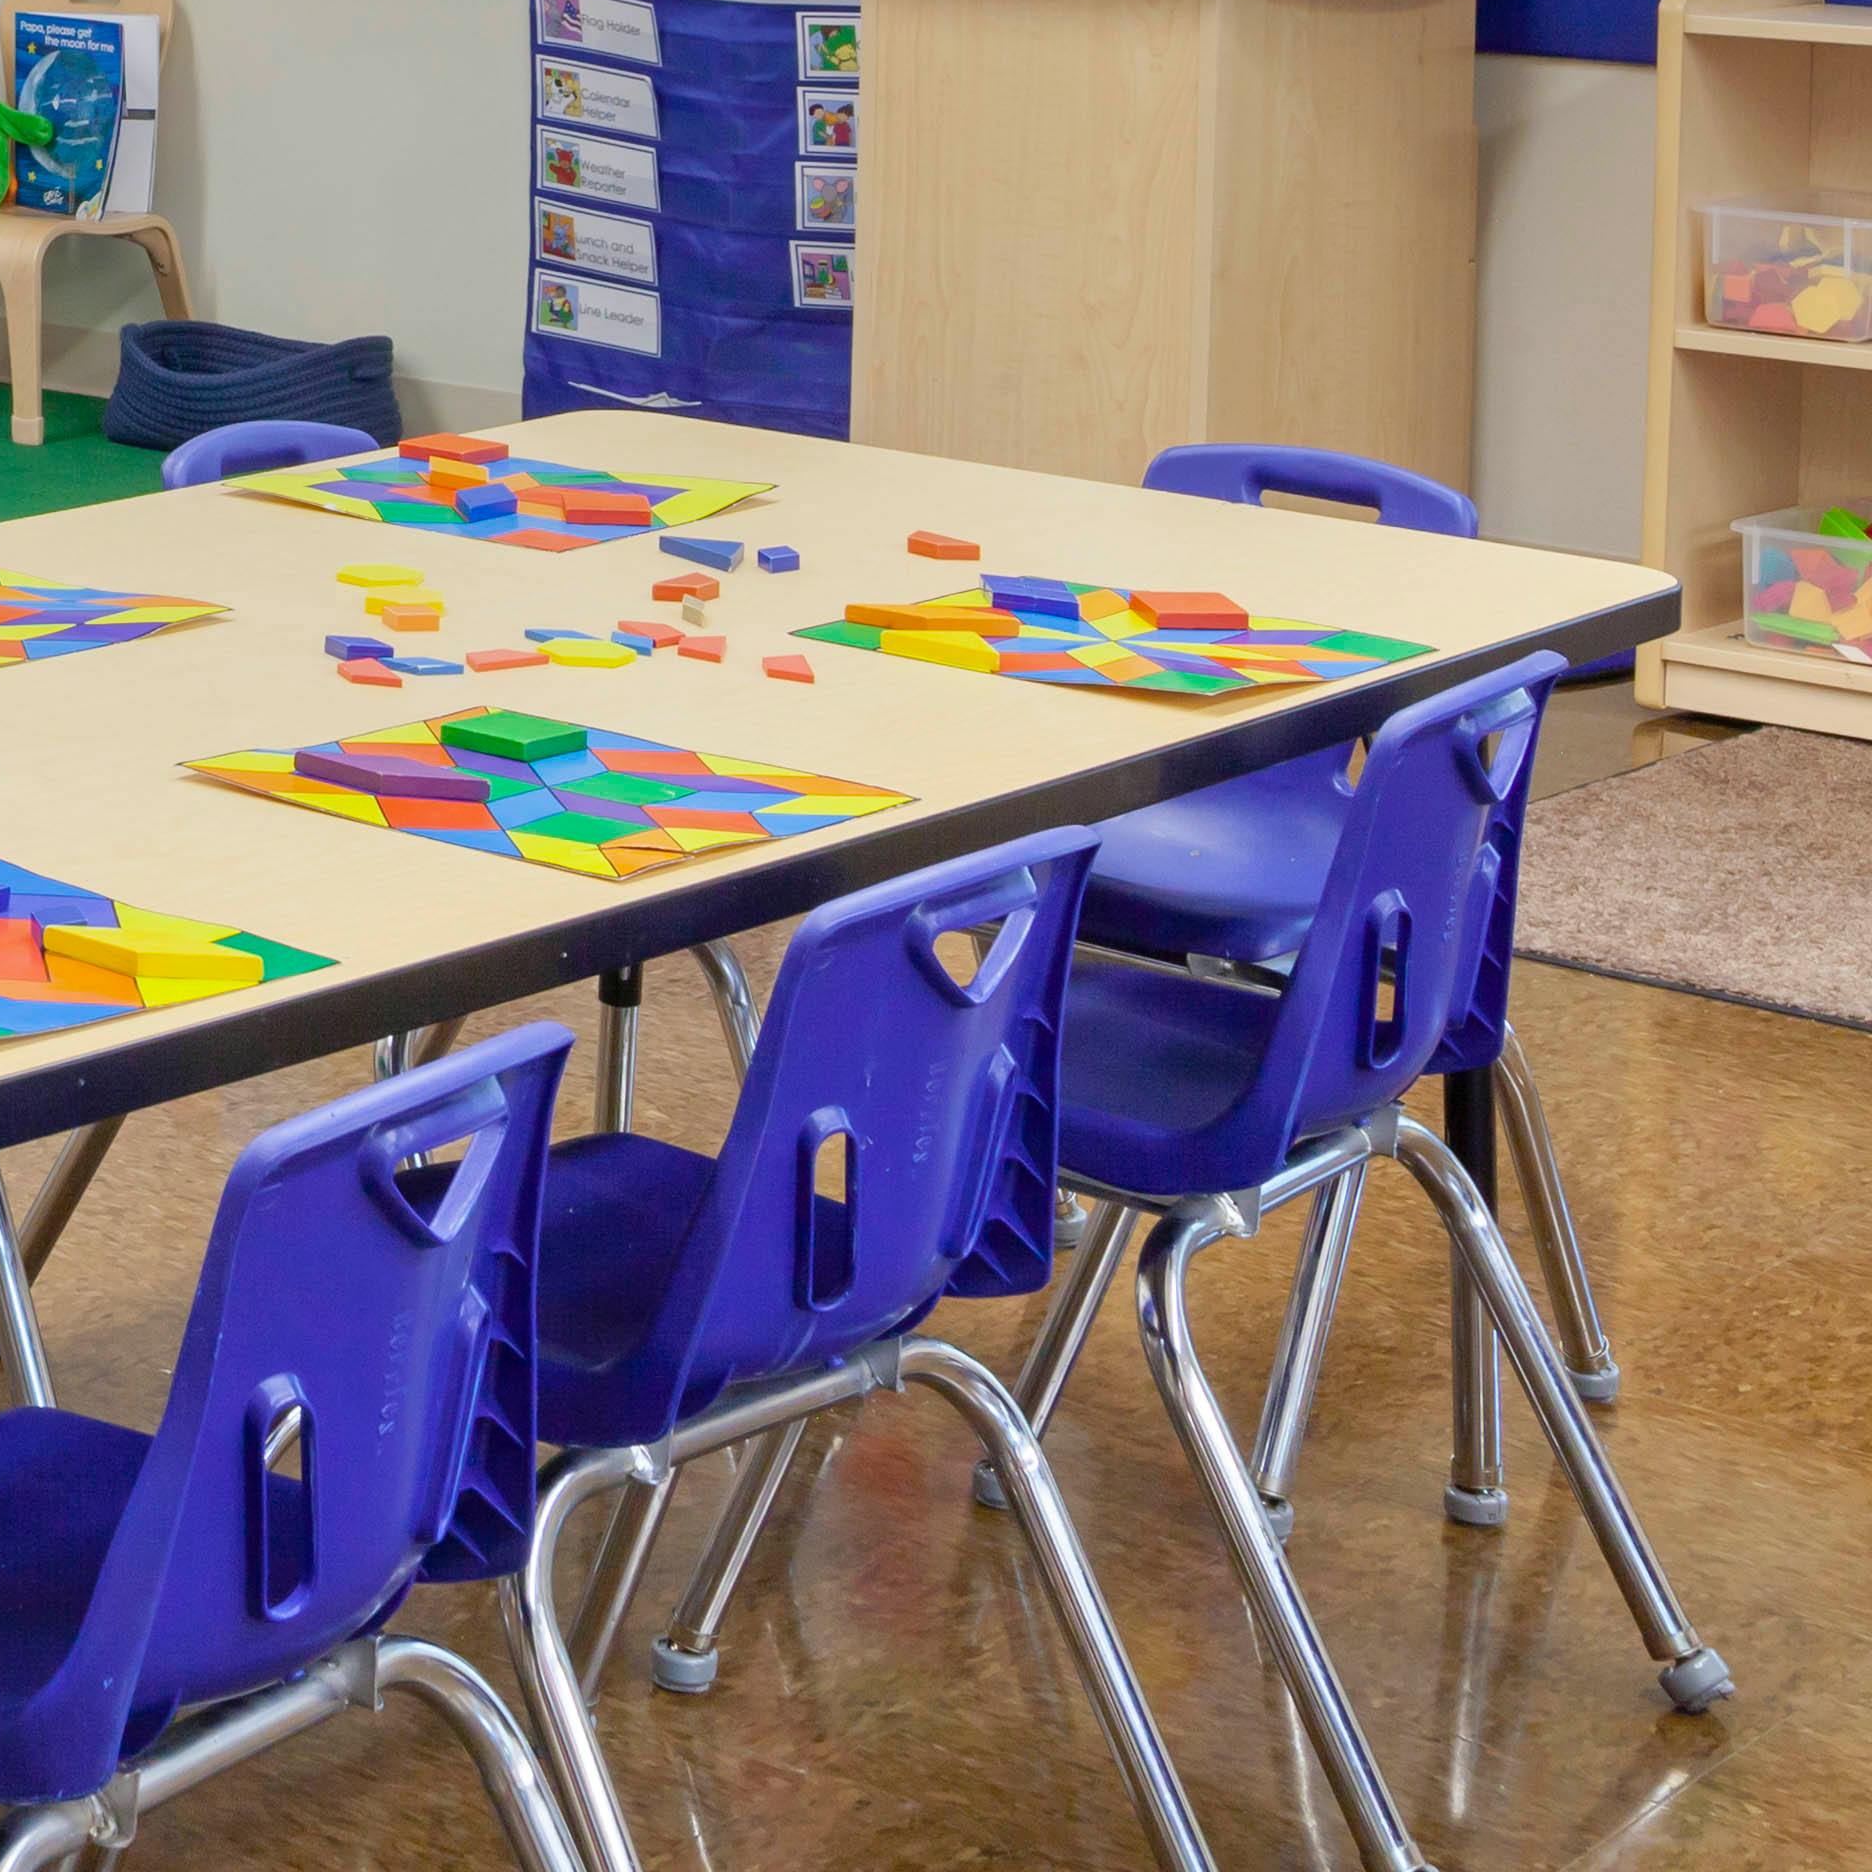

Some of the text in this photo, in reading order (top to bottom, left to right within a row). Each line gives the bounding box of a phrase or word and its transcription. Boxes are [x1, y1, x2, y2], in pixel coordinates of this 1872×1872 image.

[20, 20, 93, 39] Papa, please get
[45, 36, 114, 53] the moon for me
